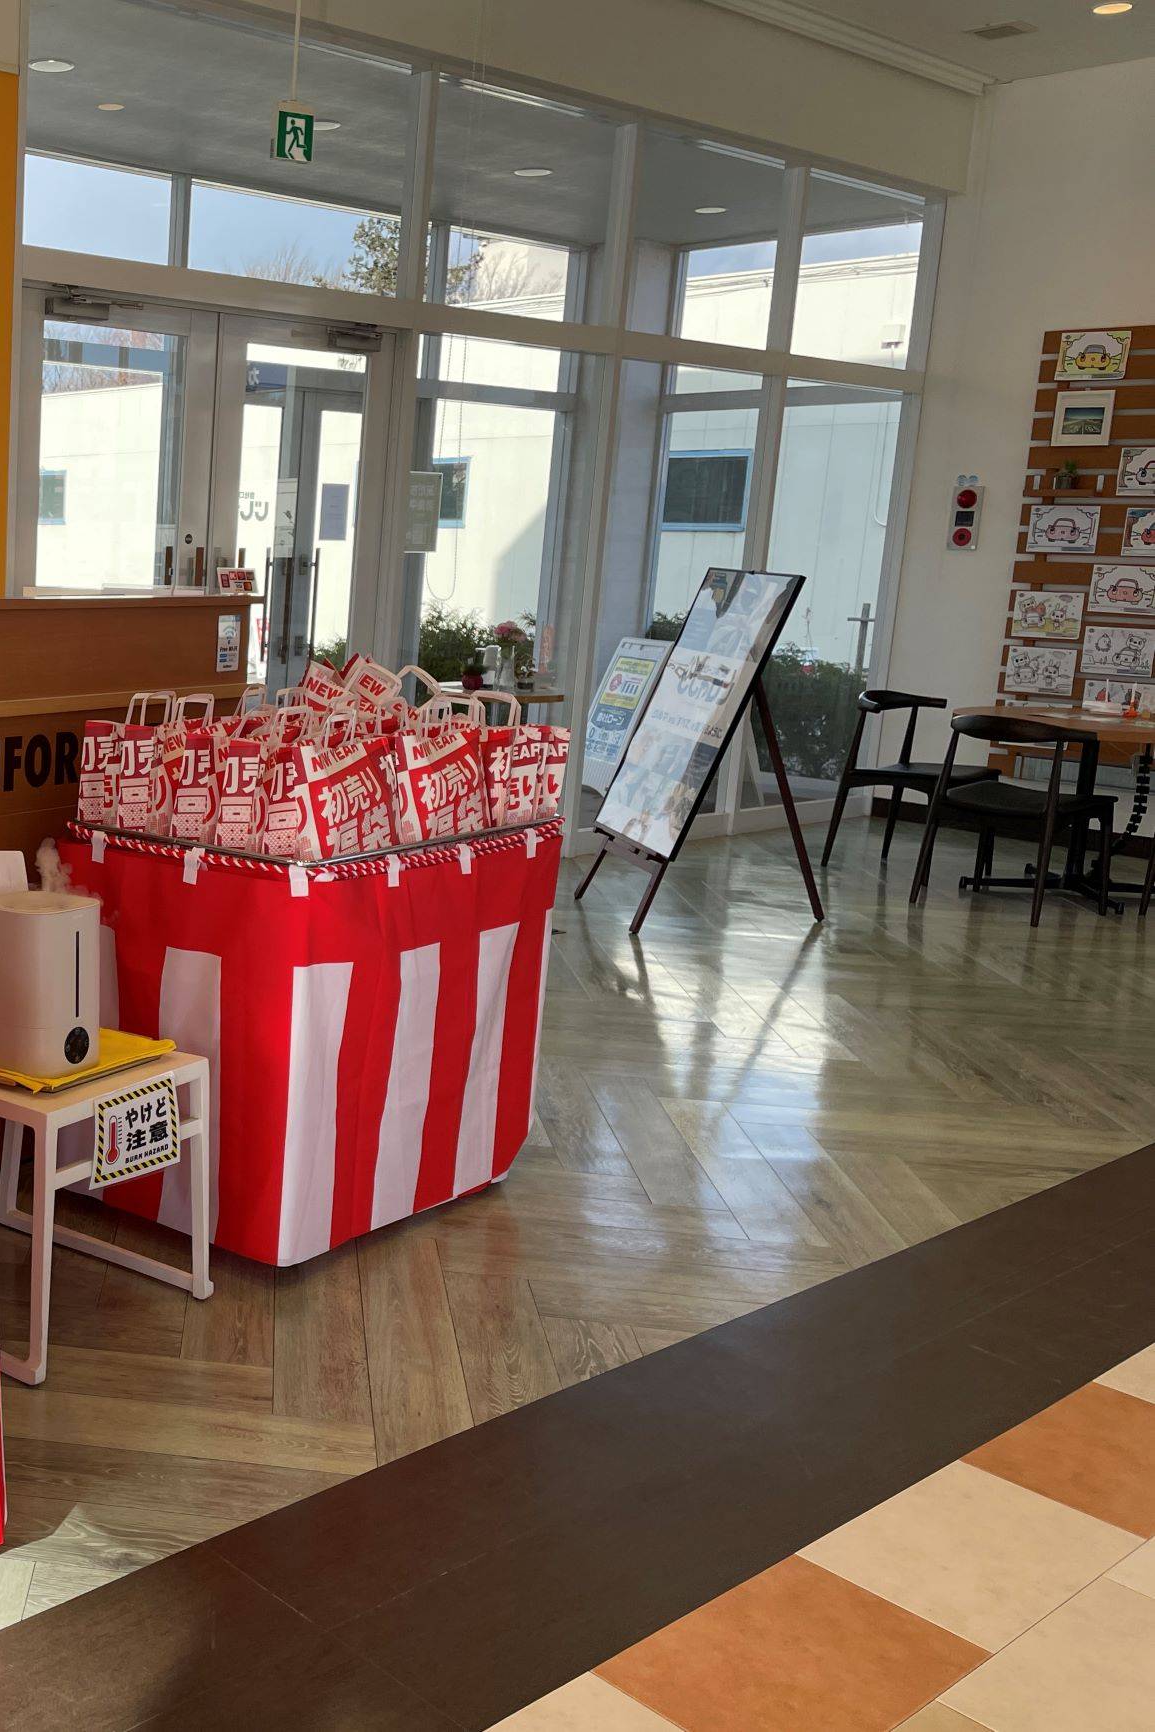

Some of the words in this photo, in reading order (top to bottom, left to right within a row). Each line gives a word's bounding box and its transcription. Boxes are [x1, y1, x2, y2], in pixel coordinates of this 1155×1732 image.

[306, 677, 344, 700] NEW
[318, 765, 383, 827] 初売り
[418, 753, 479, 812] 初売り
[124, 1095, 168, 1130] やけど
[125, 1119, 169, 1152] 注意
[124, 1153, 143, 1164] BURN
[143, 1143, 169, 1158] HAZARD
